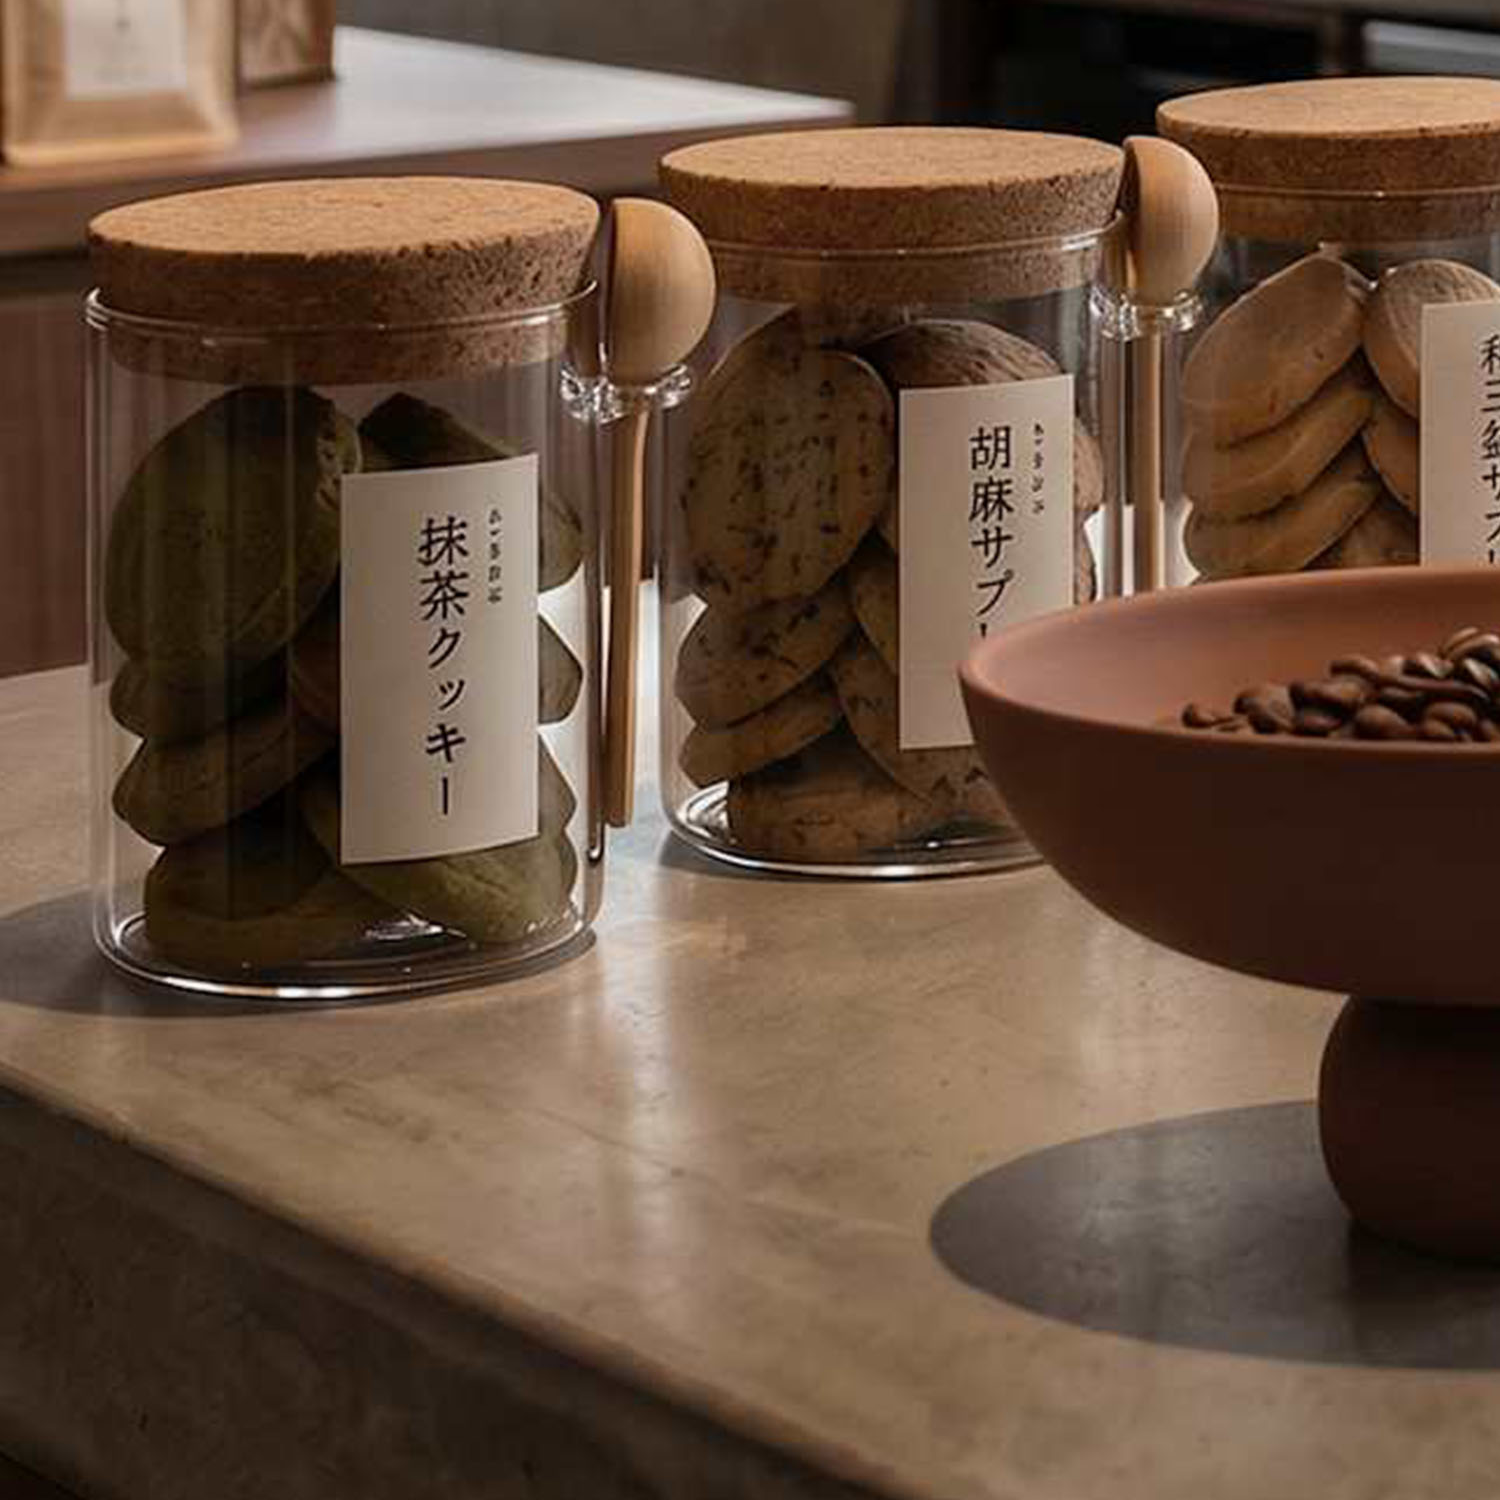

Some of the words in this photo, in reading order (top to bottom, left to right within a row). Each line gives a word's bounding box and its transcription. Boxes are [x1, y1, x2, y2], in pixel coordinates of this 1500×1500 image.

[417, 515, 470, 816] 抹茶クッキー
